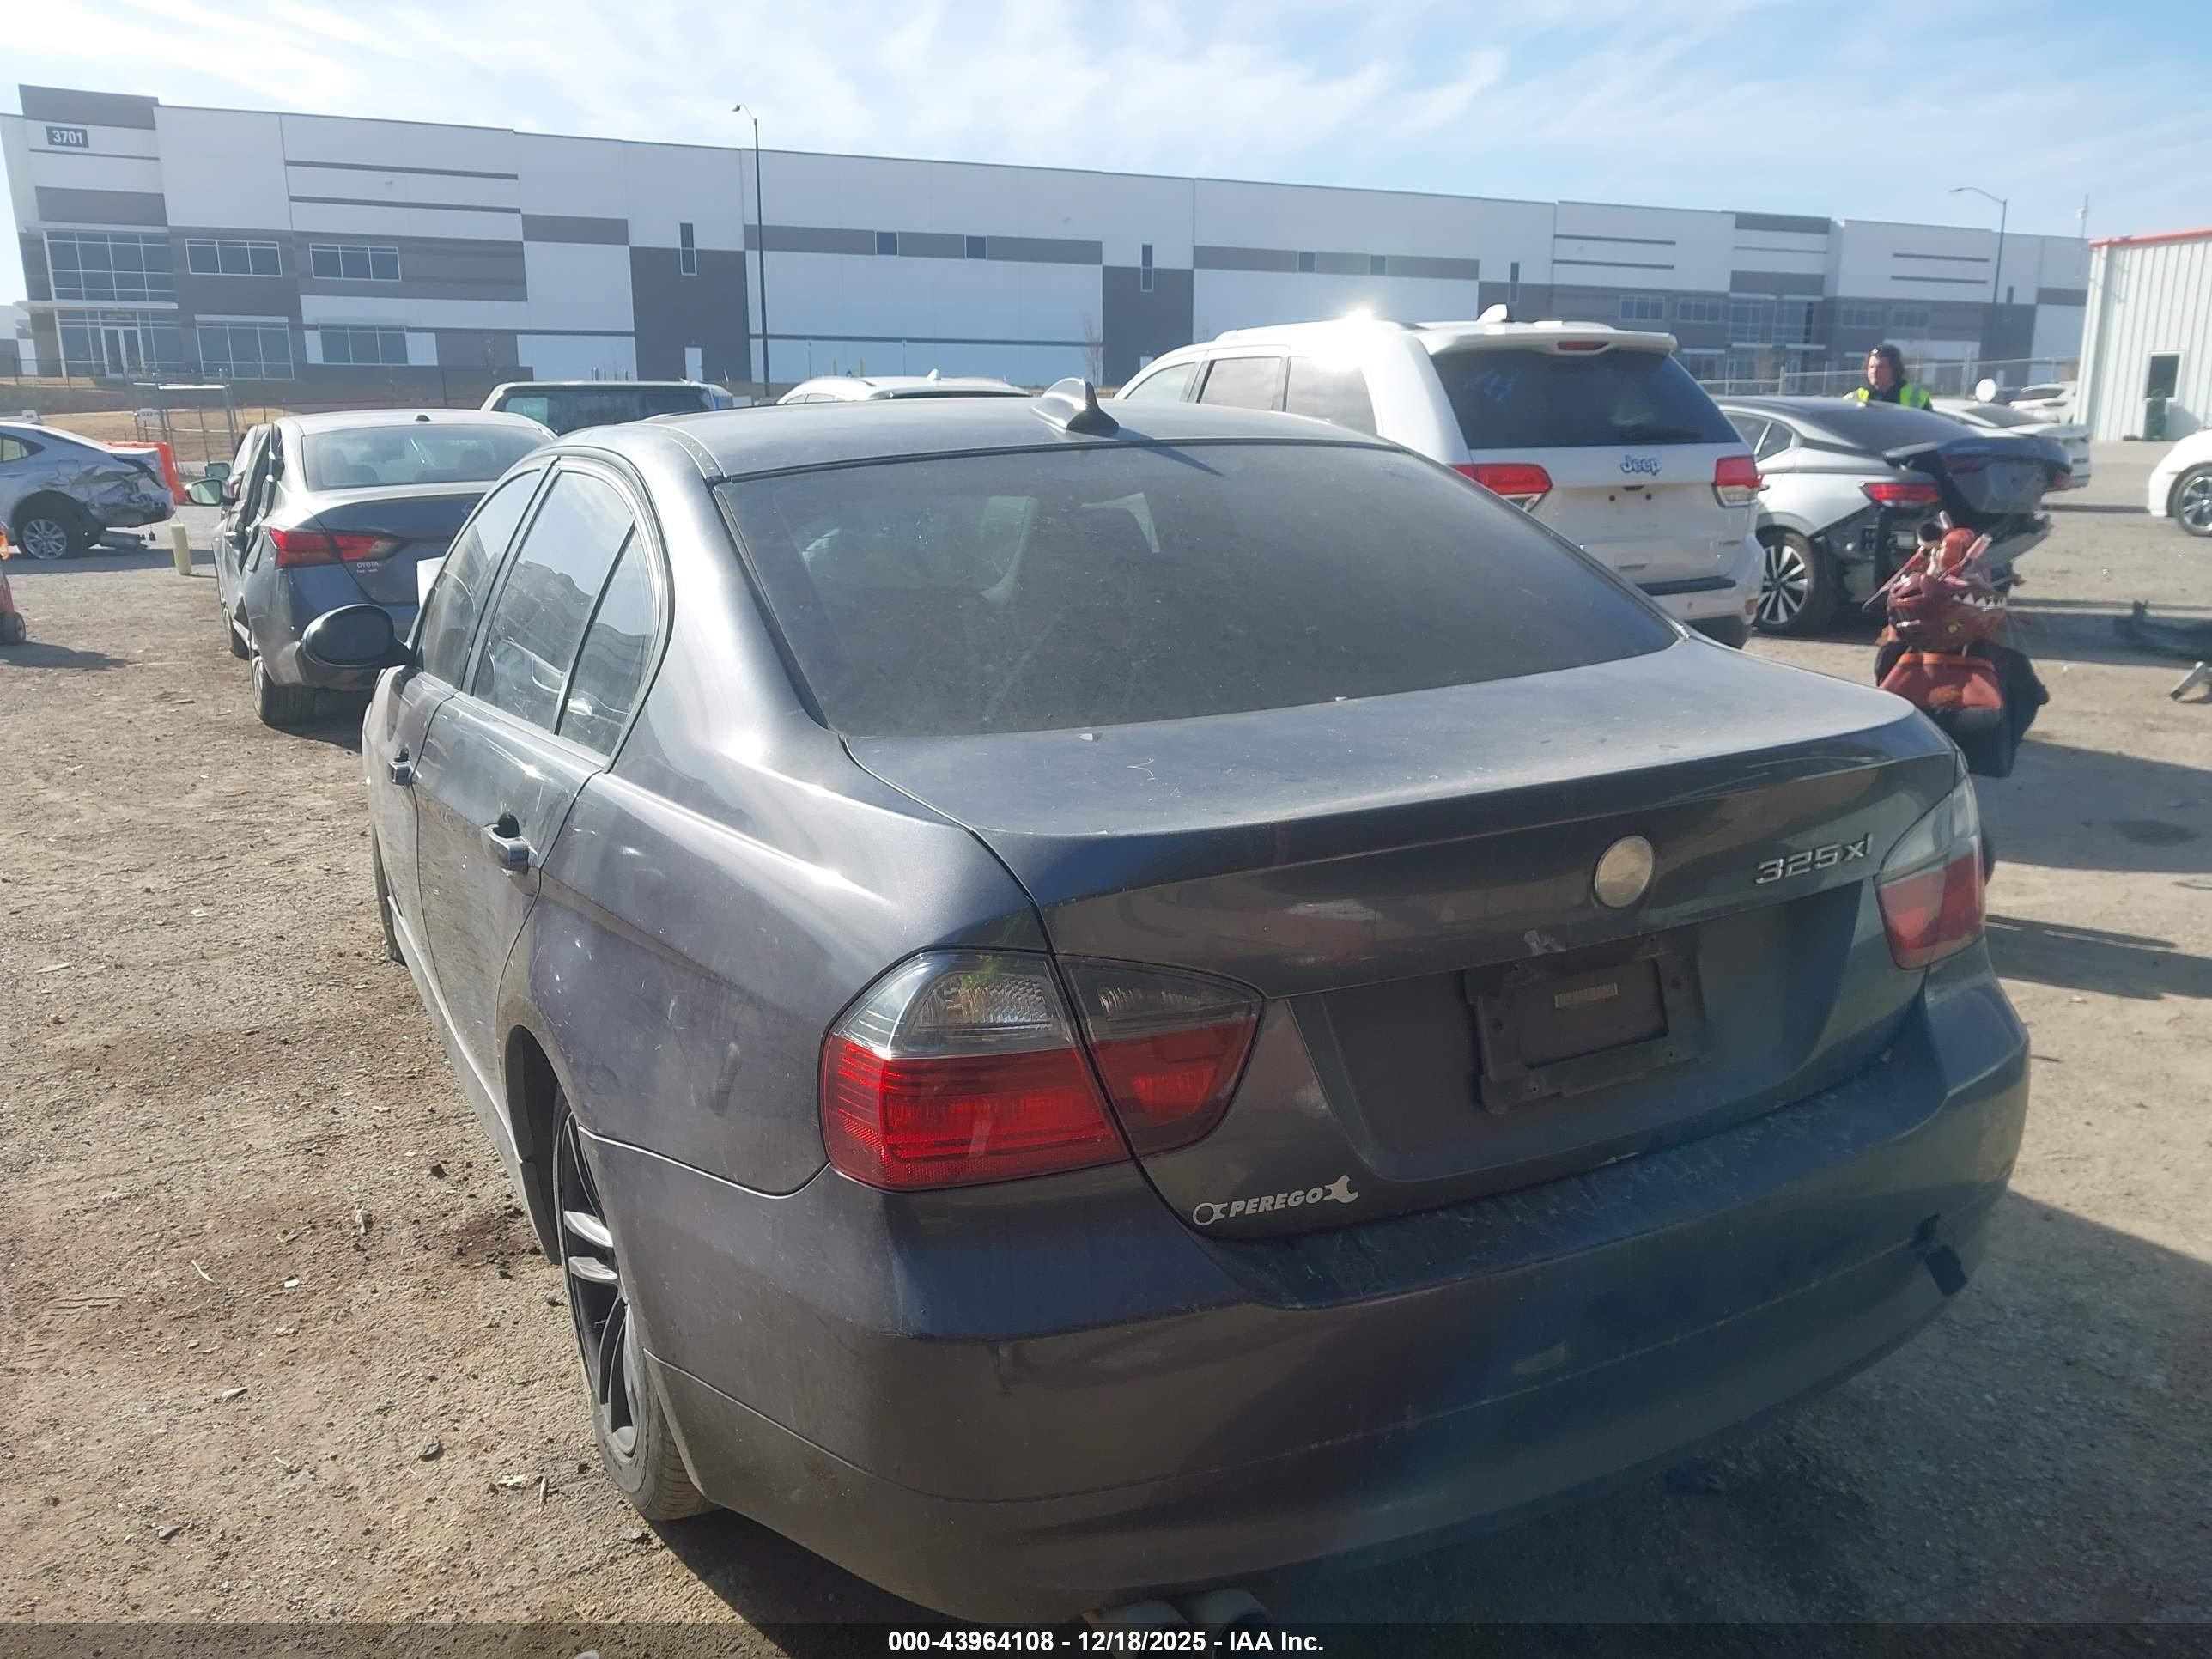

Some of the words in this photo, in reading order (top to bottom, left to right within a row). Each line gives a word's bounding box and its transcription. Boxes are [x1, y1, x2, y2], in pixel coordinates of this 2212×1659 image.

[52, 130, 84, 144] 3701
[1620, 454, 1661, 477] Jeep
[1754, 832, 1874, 884] 325xi
[1229, 1187, 1324, 1218] PEREGO
